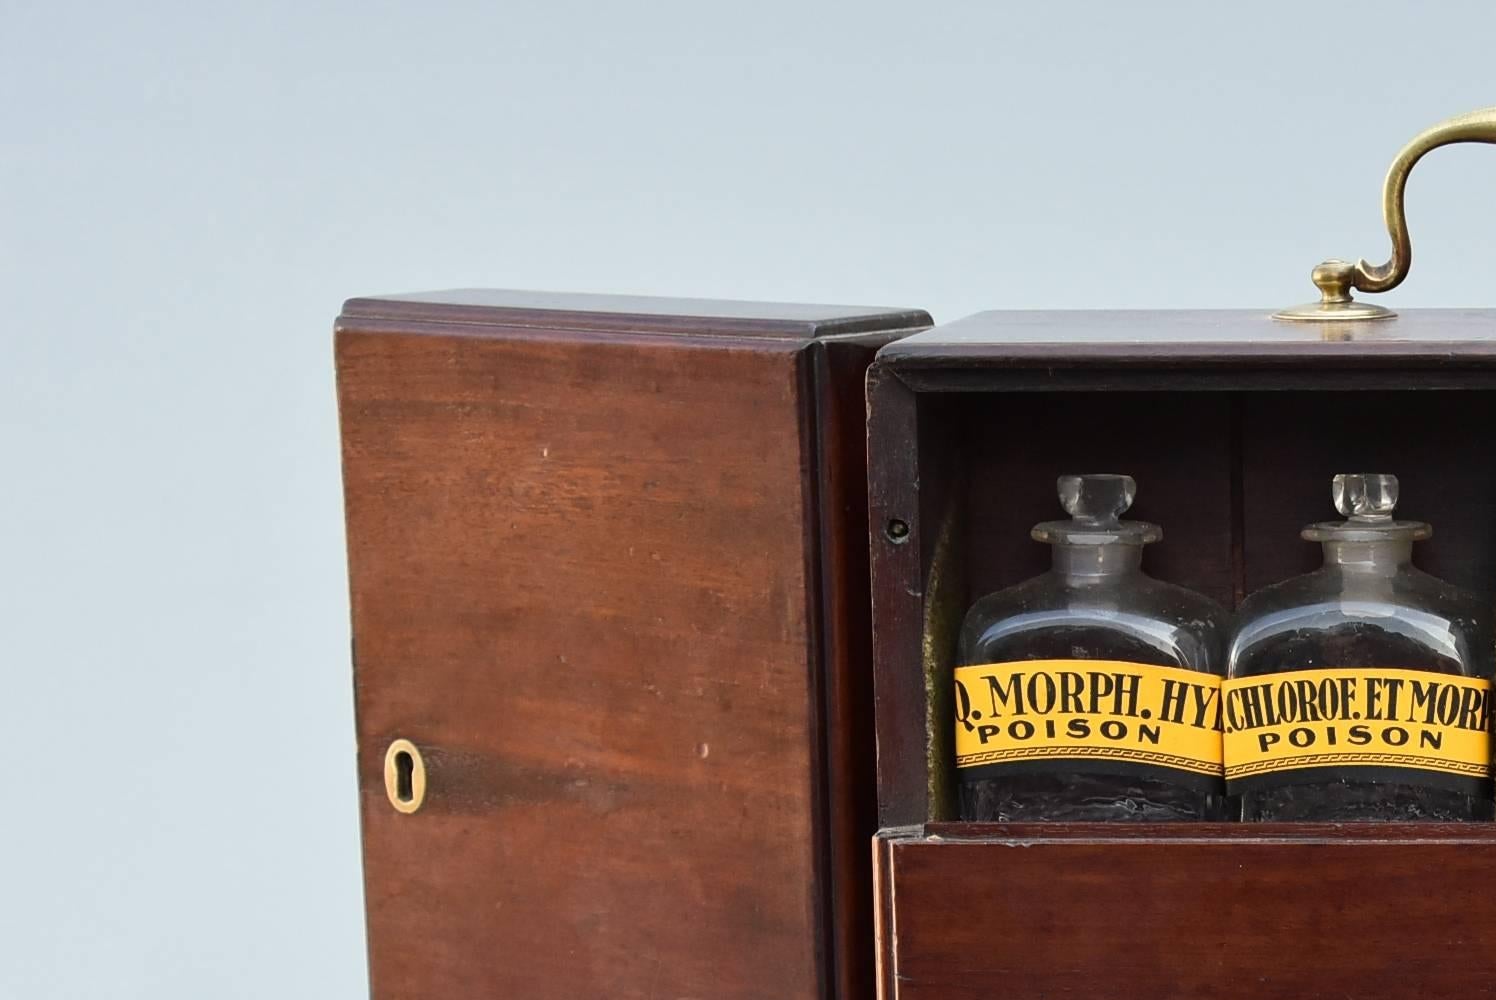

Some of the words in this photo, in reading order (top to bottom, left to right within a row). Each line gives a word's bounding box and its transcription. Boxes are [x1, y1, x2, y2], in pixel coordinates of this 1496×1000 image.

[980, 671, 1152, 719] MORPH.
[977, 718, 1161, 744] POISON
[1258, 724, 1443, 752] POISON
